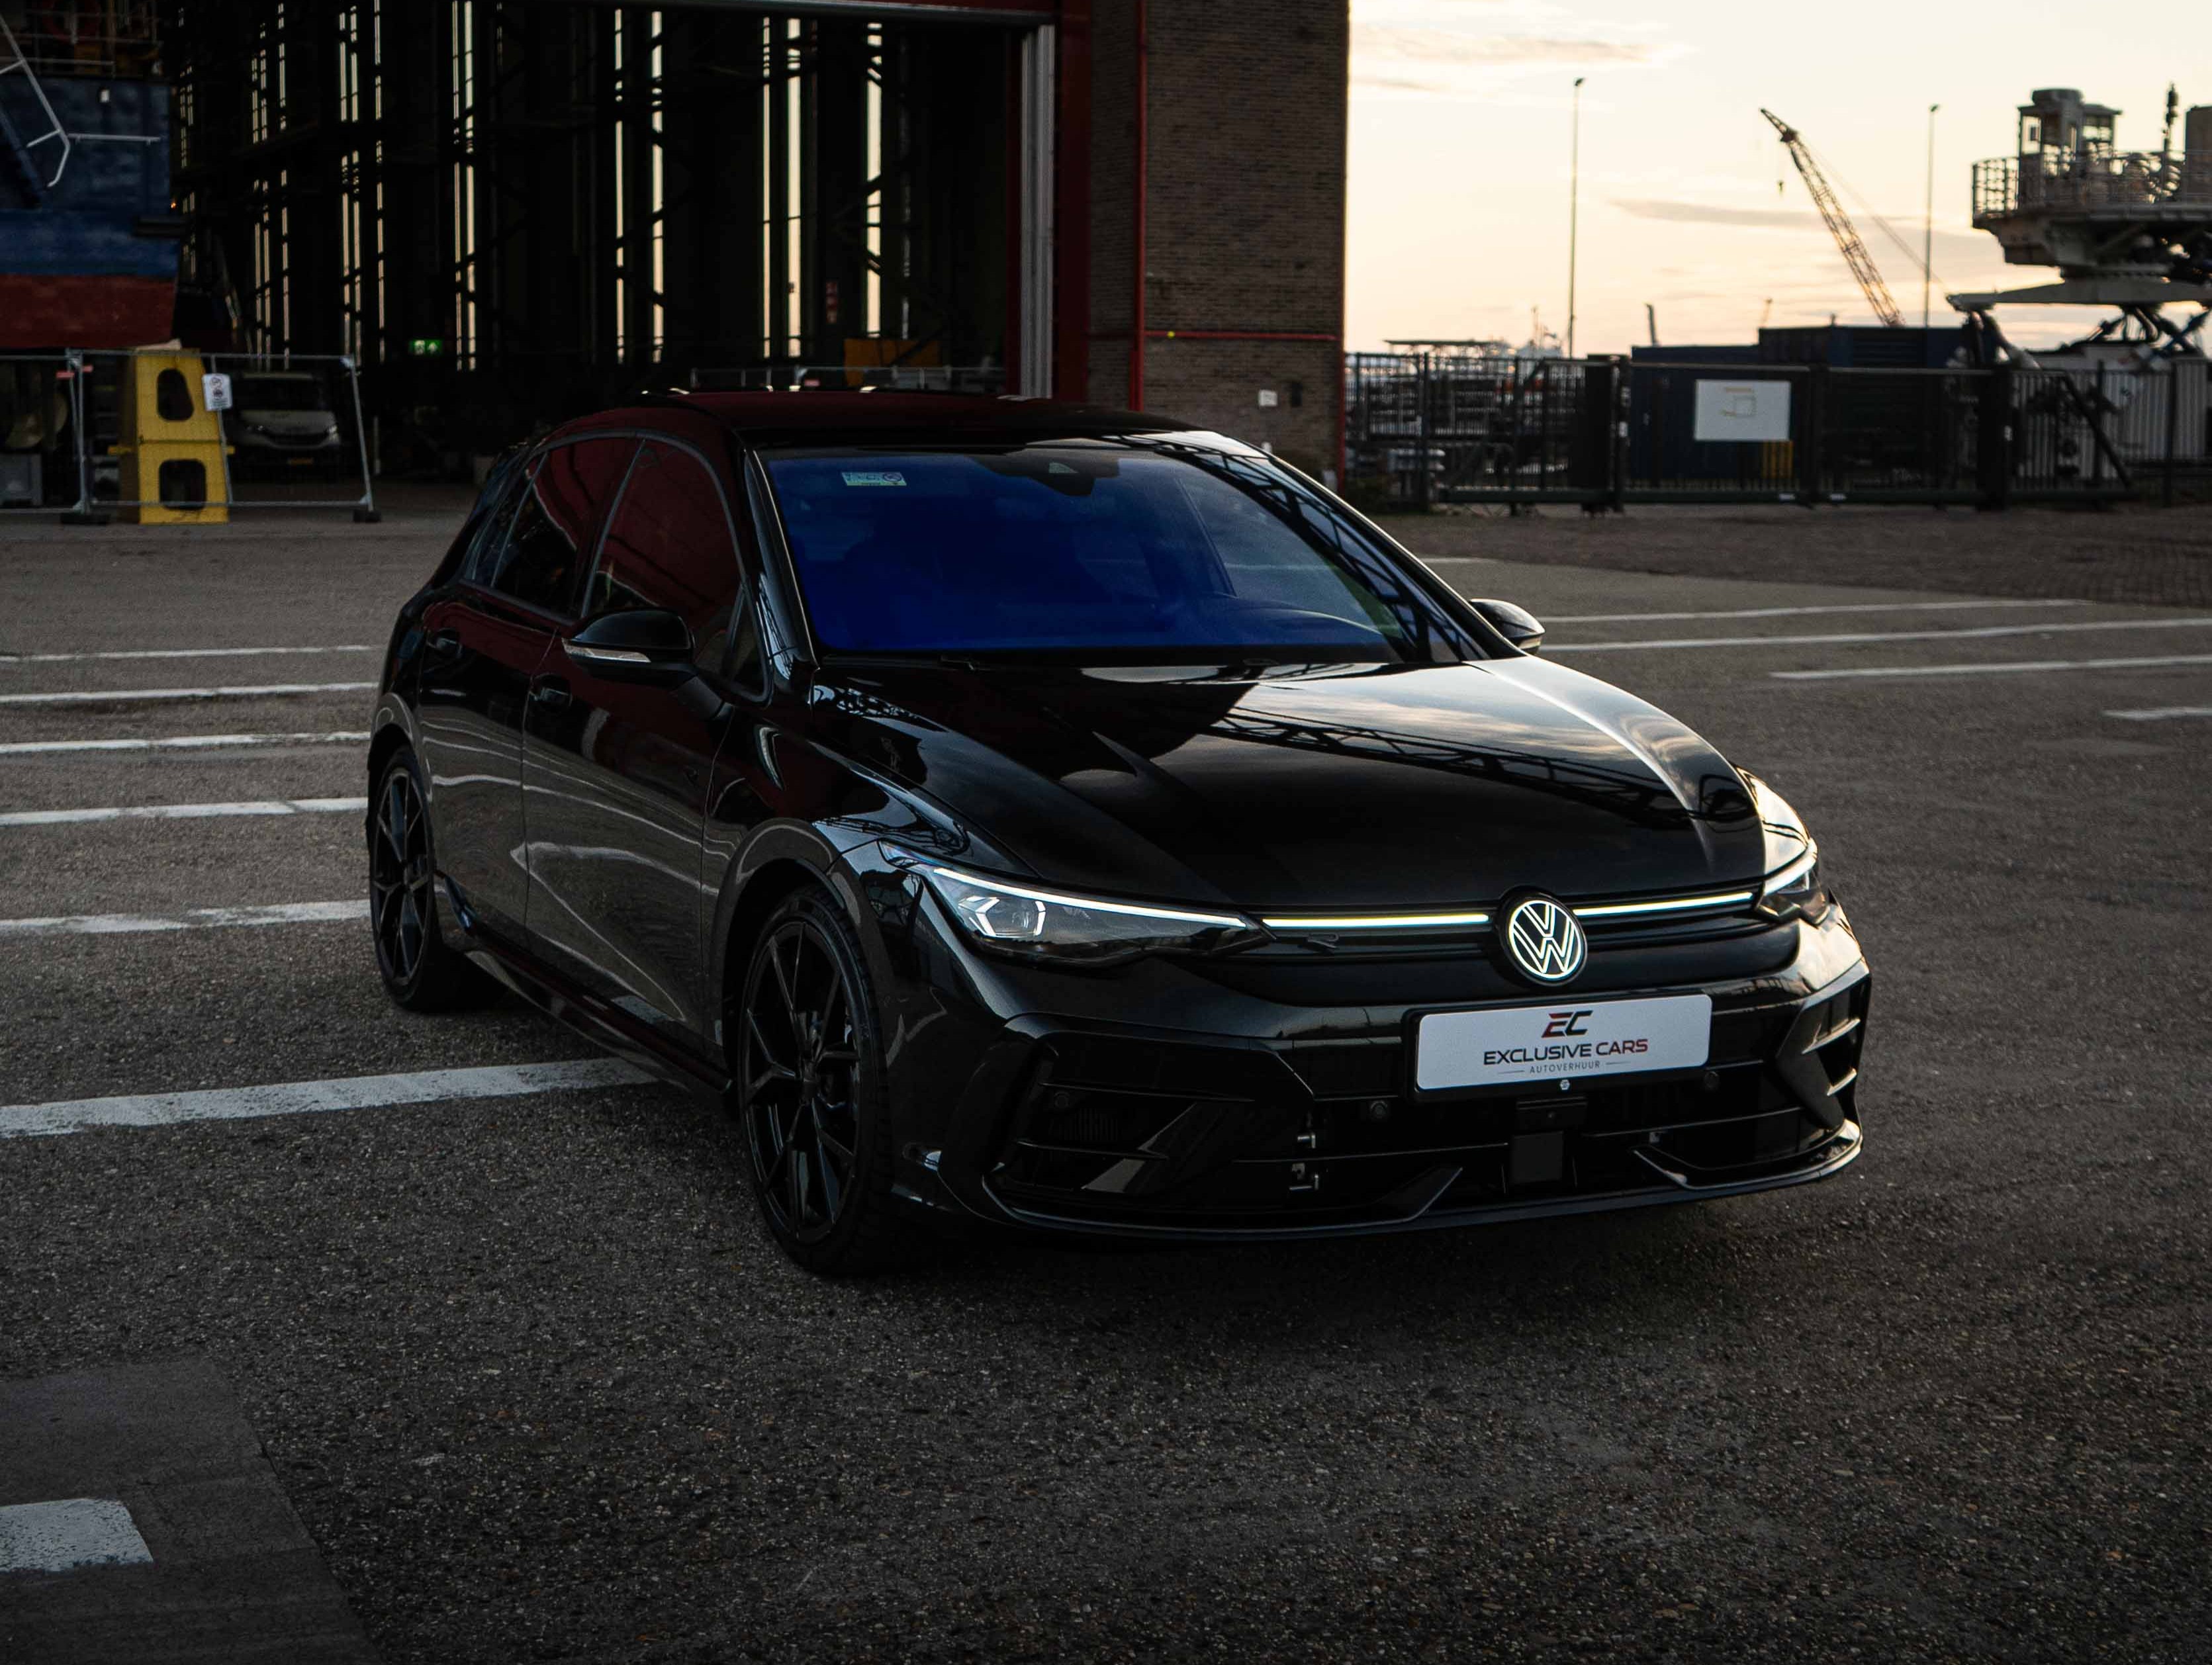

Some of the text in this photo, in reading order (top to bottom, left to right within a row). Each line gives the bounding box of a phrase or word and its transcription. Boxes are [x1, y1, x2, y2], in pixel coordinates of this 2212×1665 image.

[1511, 903, 1579, 975] VW
[1542, 1011, 1593, 1038] EC
[1483, 1039, 1648, 1065] EXCLUSIVE CARS
[1530, 1061, 1600, 1073] AUTOVERHUUR
